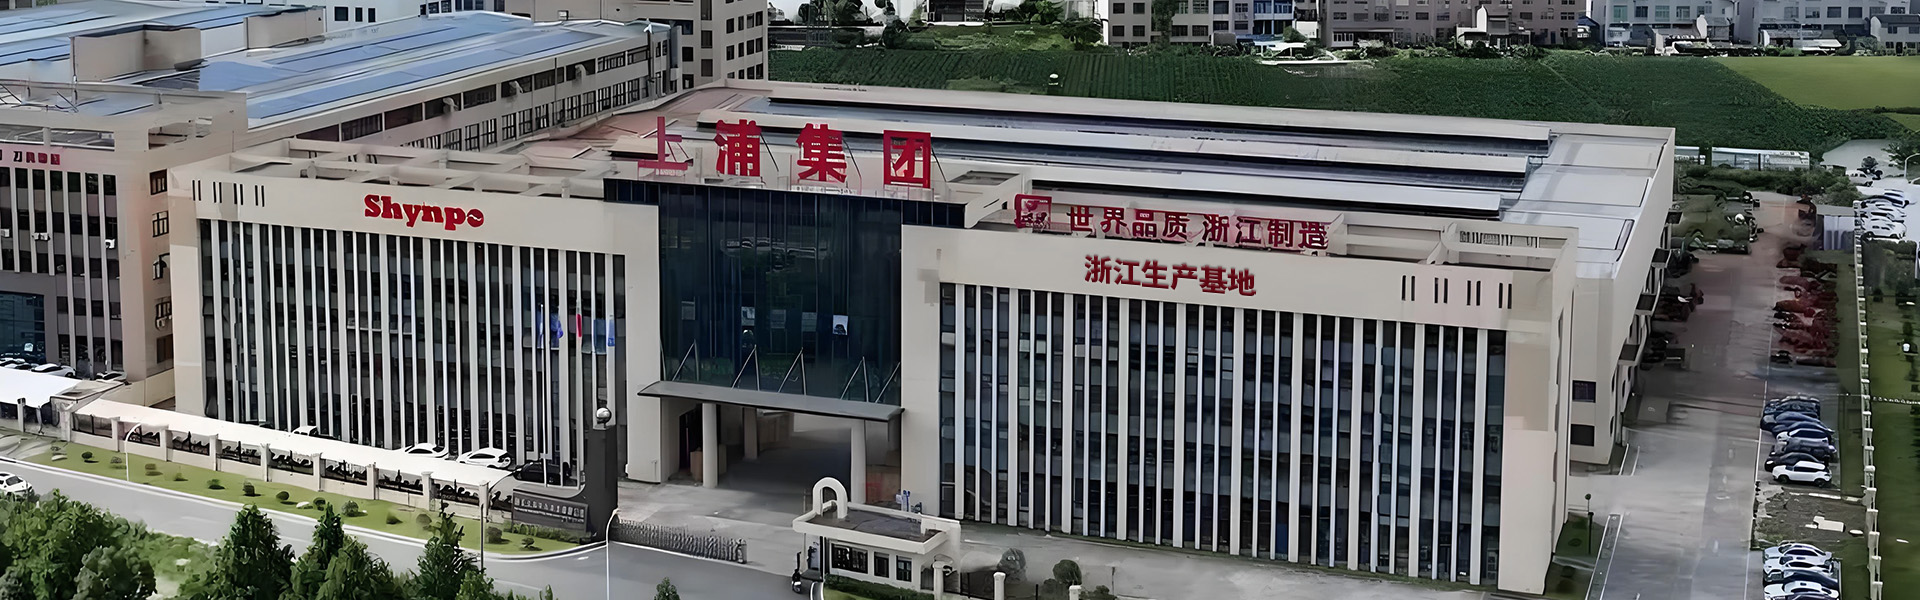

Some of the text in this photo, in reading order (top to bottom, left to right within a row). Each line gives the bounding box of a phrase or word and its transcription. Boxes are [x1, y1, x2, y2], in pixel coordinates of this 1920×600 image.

[638, 116, 932, 188] 上浦集团
[364, 194, 484, 231] Shynpo
[1068, 205, 1189, 240] 世界品质
[1201, 213, 1329, 250] 浙江制造
[1084, 254, 1257, 297] 浙江生产基地
